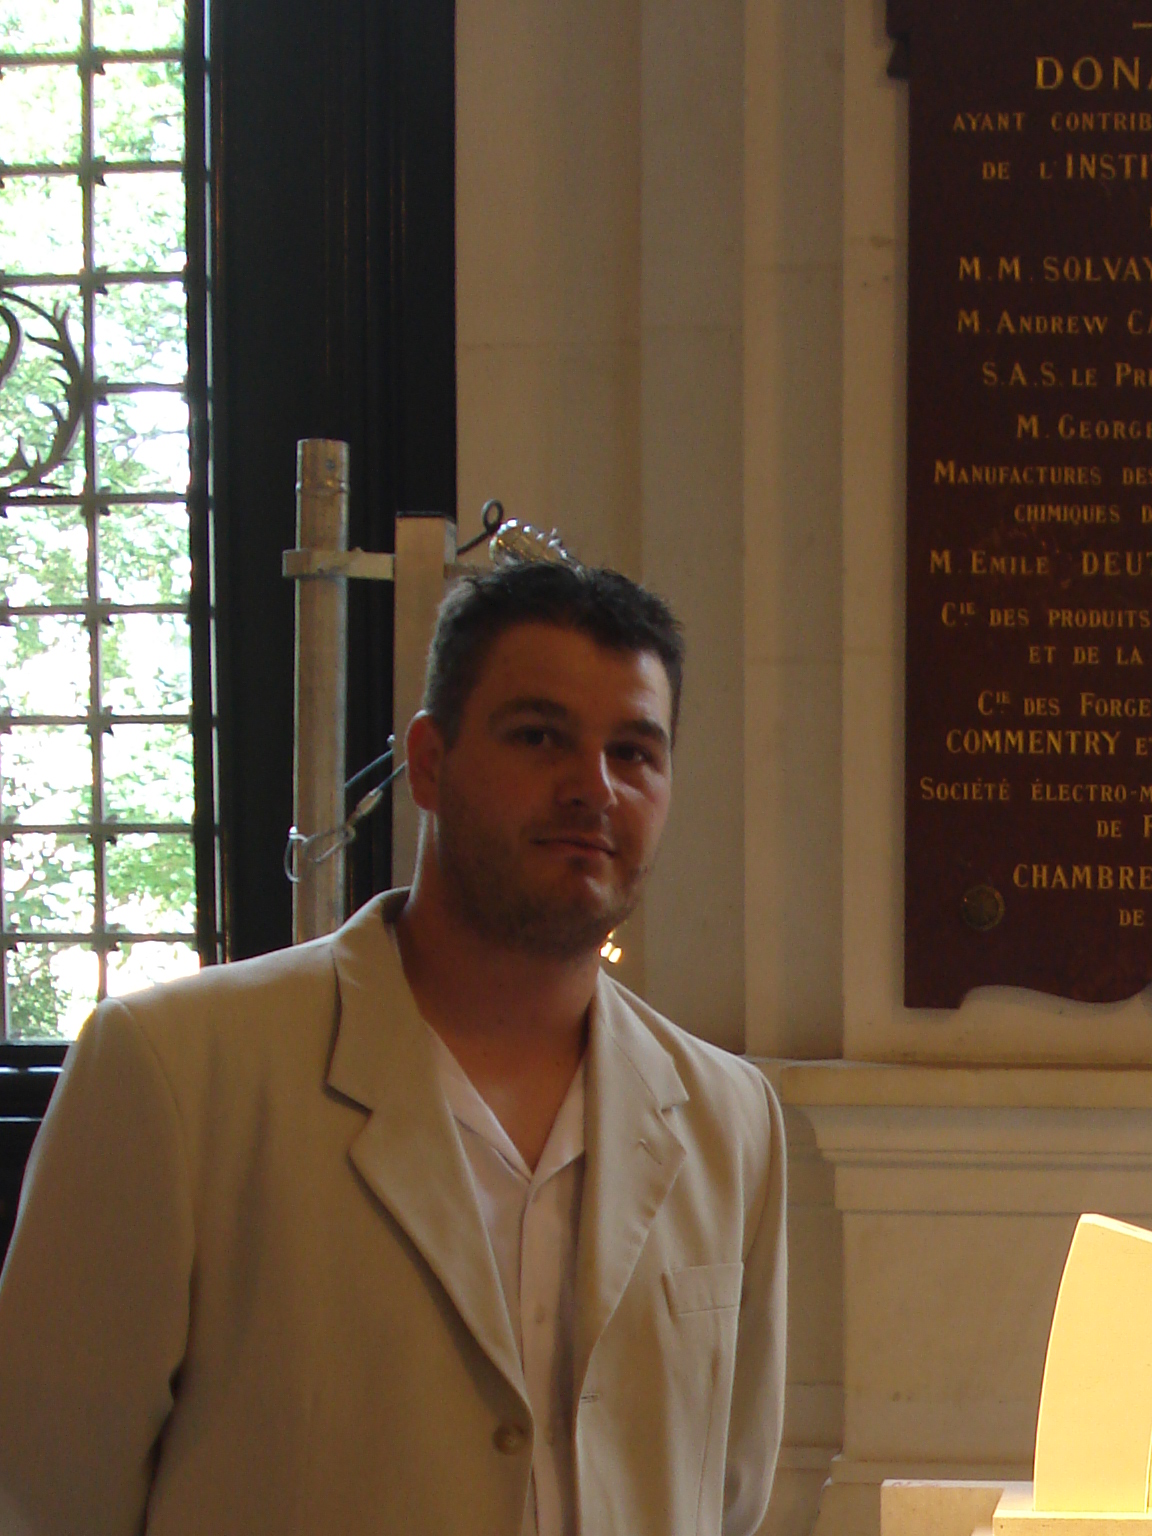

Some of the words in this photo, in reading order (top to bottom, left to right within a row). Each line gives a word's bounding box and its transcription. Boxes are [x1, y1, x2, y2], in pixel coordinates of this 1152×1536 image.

[953, 112, 1024, 132] AYANT
[982, 161, 1008, 180] DE
[1071, 368, 1097, 387] LE
[1014, 504, 1120, 525] CHIMIQUES
[989, 608, 1030, 627] DES
[1048, 608, 1151, 628] PRODUITS
[1029, 645, 1056, 664] ET
[1073, 646, 1099, 665] DE
[1116, 646, 1144, 666] LA
[1023, 697, 1061, 717] DES
[946, 729, 1119, 755] COMMENTRY
[1097, 820, 1122, 838] DE
[1012, 864, 1152, 890] CHAMBRE
[1119, 909, 1144, 927] DE
